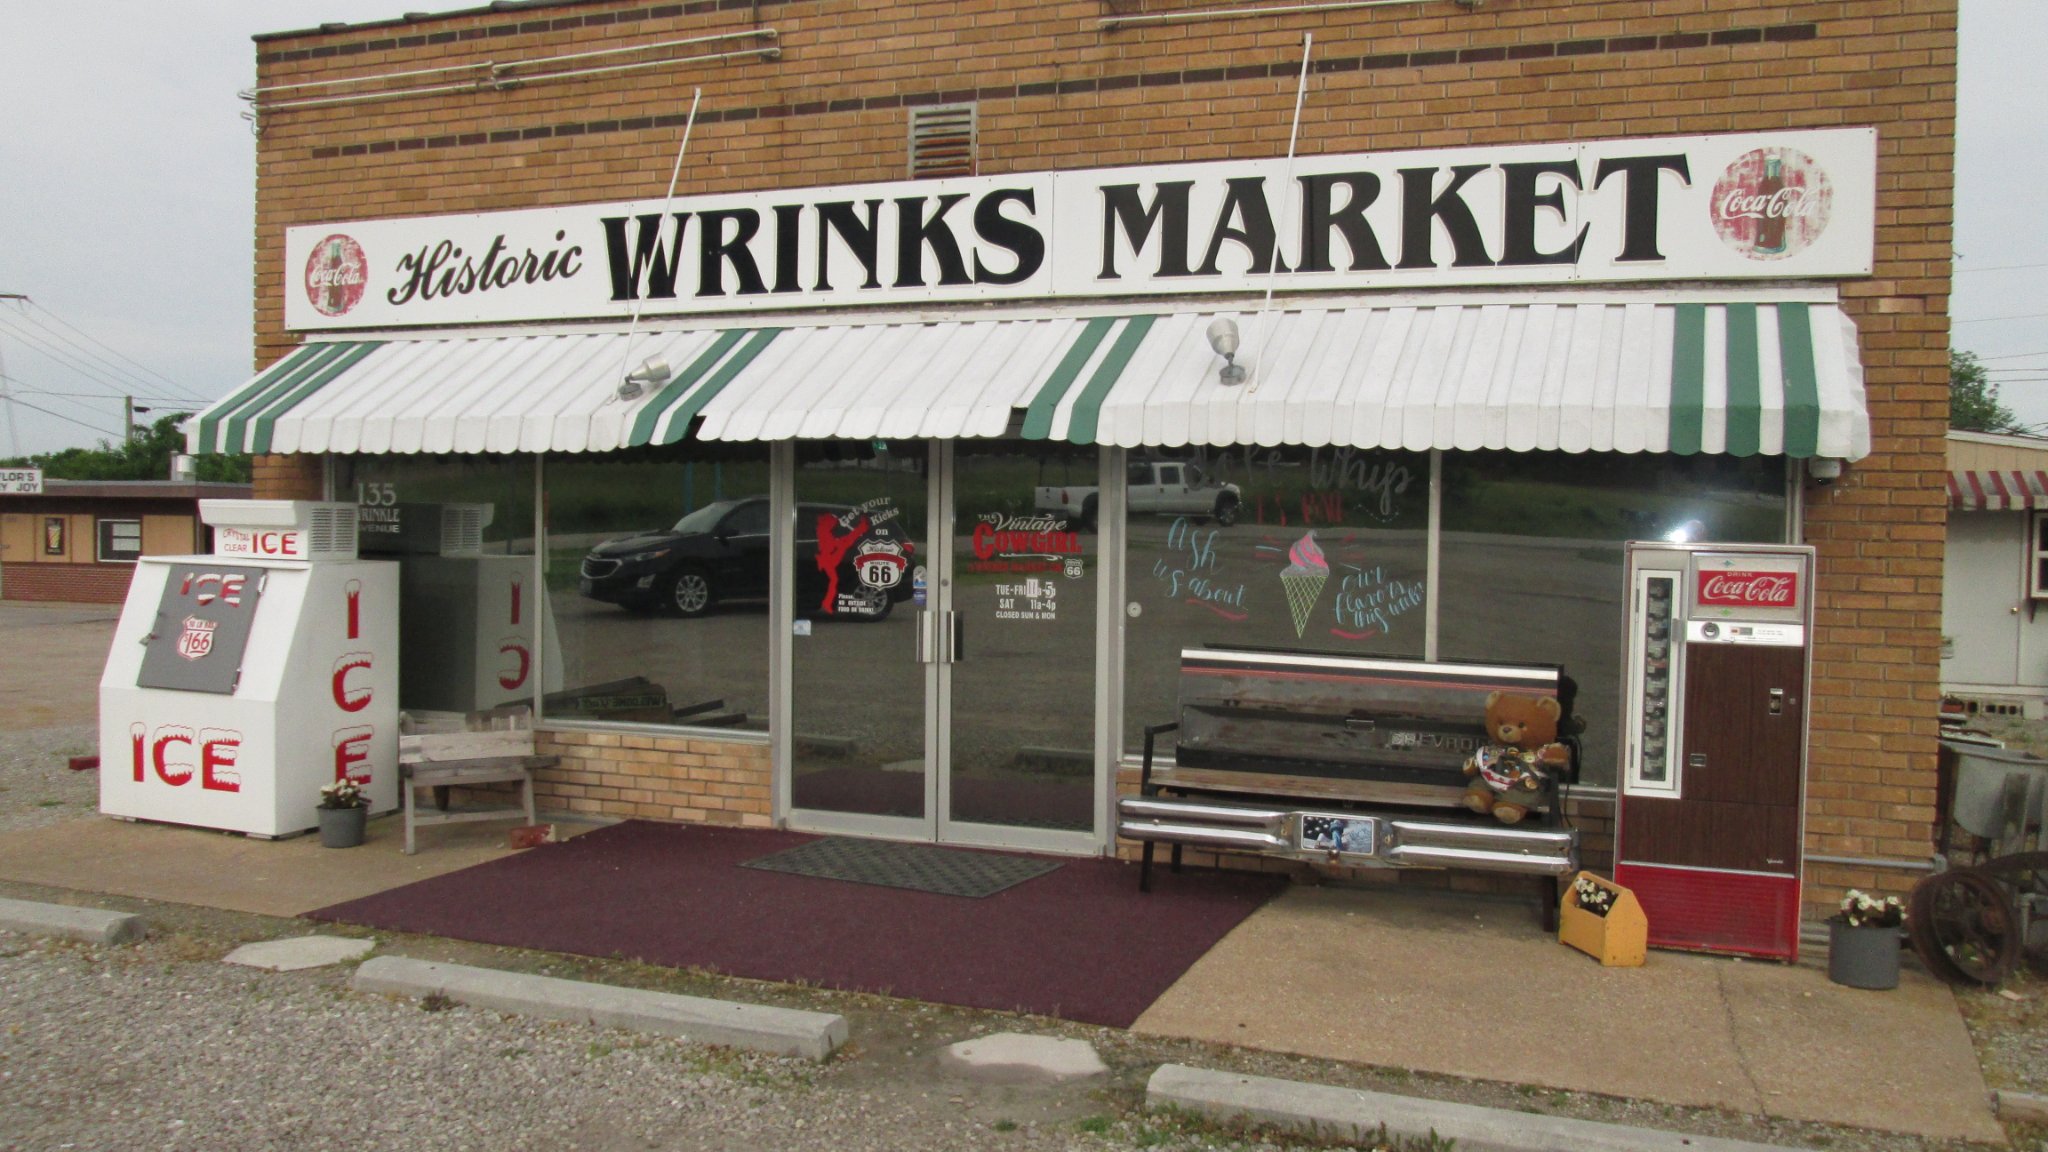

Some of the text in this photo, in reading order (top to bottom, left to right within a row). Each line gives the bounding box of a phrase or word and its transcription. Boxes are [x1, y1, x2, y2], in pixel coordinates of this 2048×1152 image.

[387, 153, 1692, 306] Historic WRINKS MARKET
[0, 472, 34, 482] LOR'S
[358, 482, 396, 507] 135
[861, 496, 891, 513] your
[358, 508, 400, 523] RINKLE
[870, 507, 900, 526] Kicks
[995, 512, 1068, 535] Vintage
[875, 528, 888, 536] on
[224, 544, 247, 552] CLEAR
[252, 531, 299, 555] ICE
[869, 566, 891, 583] 66
[1066, 566, 1081, 576] 66
[181, 572, 247, 608] ICE
[1703, 575, 1791, 602] Coca-Cola
[1000, 598, 1015, 609] SAT
[996, 611, 1019, 619] CLOSED
[129, 721, 243, 793] ICE
